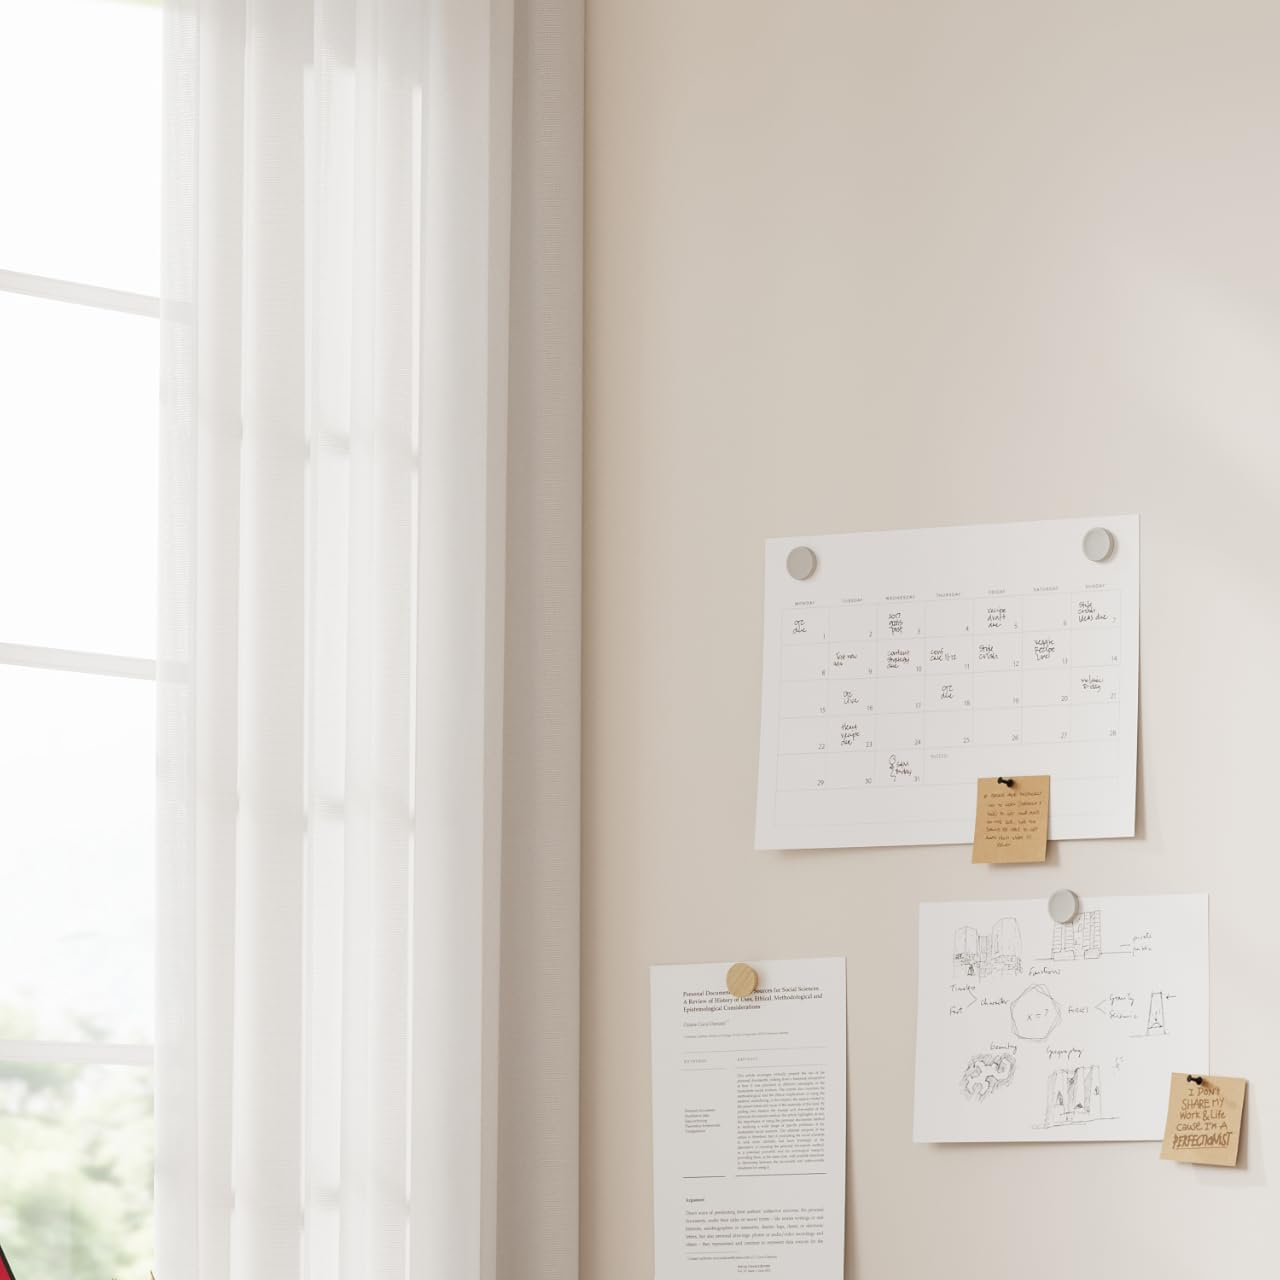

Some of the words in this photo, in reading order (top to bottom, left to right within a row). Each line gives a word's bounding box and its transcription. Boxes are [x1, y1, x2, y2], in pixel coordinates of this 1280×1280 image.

[1188, 1088, 1195, 1096] I
[1181, 1098, 1210, 1111] SHARE
[1212, 1097, 1224, 1108] MY
[1172, 1131, 1233, 1150] PERFECTIONIST
